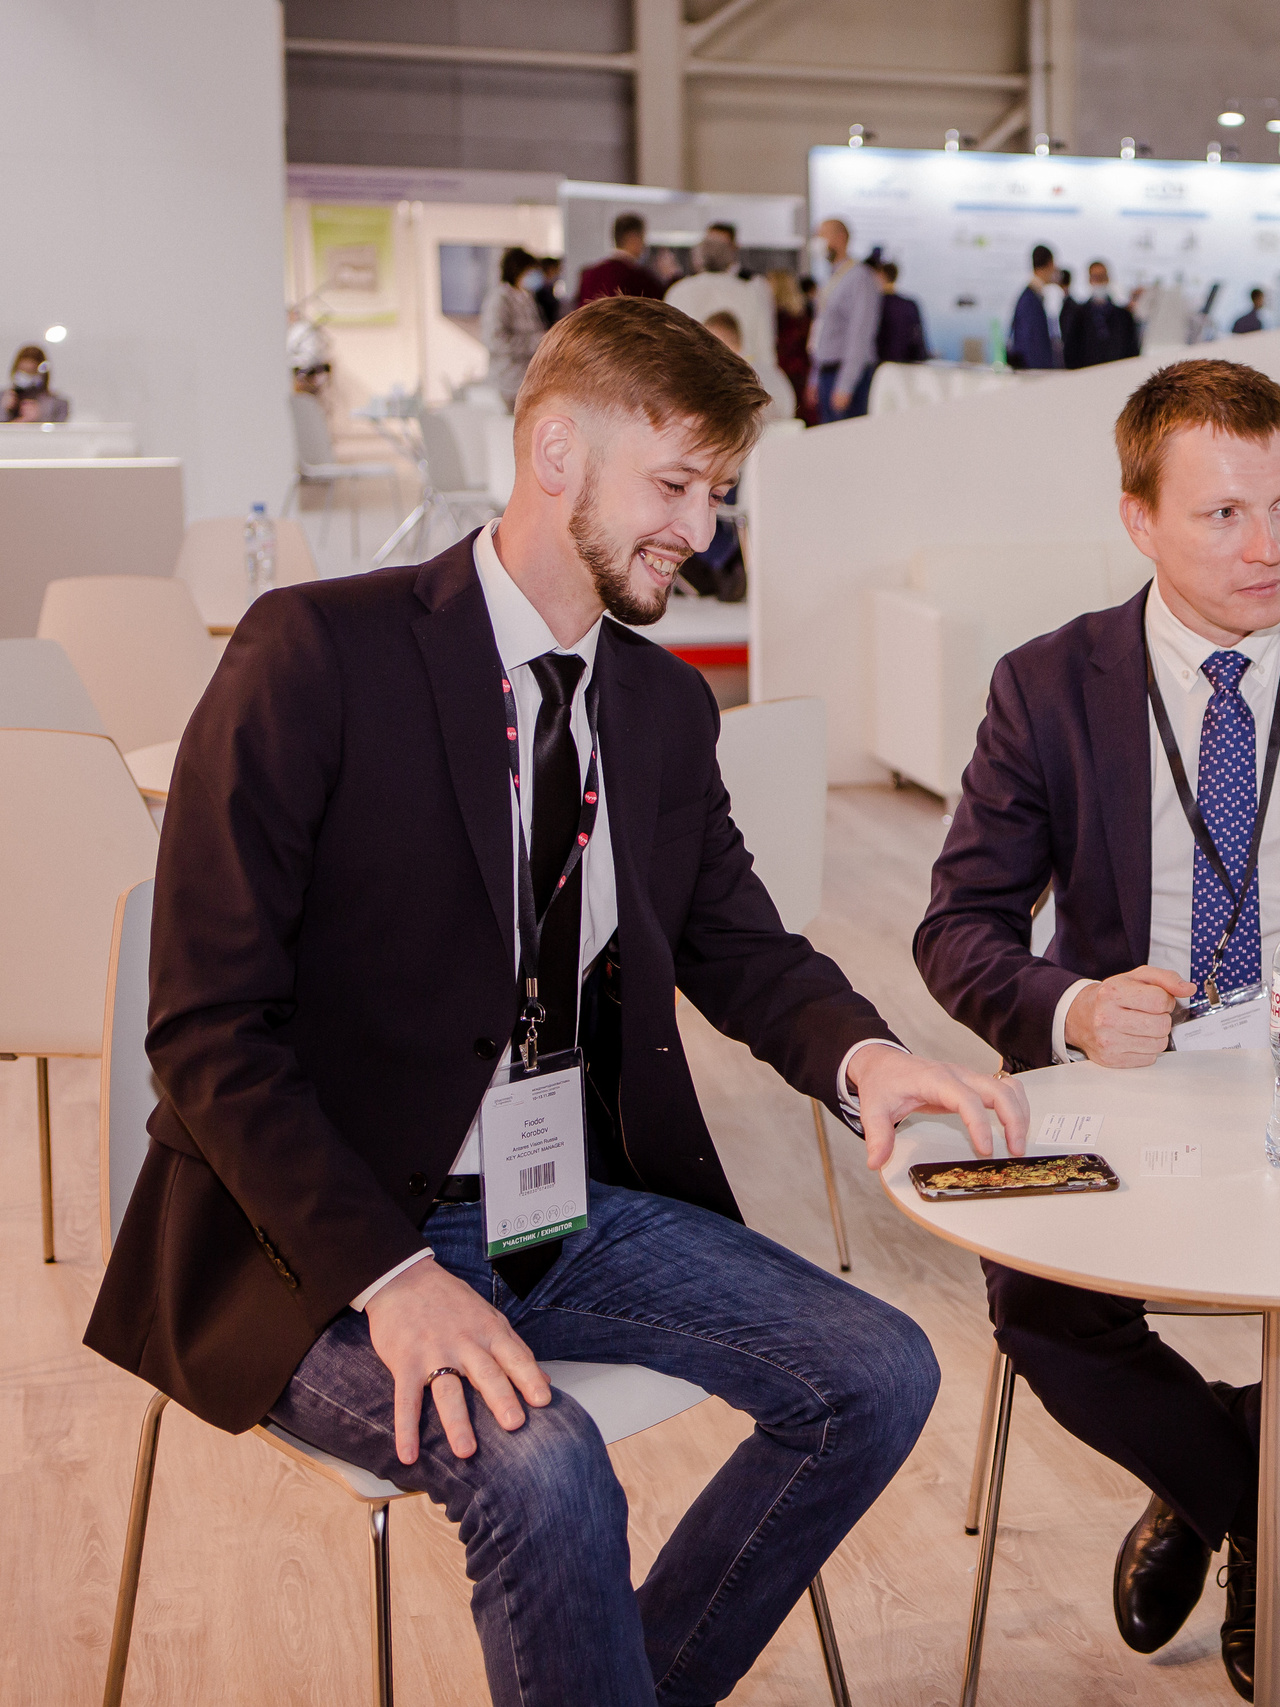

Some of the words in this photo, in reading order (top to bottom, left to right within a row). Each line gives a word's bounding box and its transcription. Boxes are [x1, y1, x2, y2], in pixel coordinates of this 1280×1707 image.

[524, 1117, 545, 1128] Fiodor
[521, 1127, 549, 1139] Korobov
[517, 1148, 540, 1159] ACCOUNT
[541, 1141, 565, 1152] MANAGER
[502, 1233, 536, 1248] УЧАСТНИК
[541, 1221, 573, 1237] EXHIBITOR
